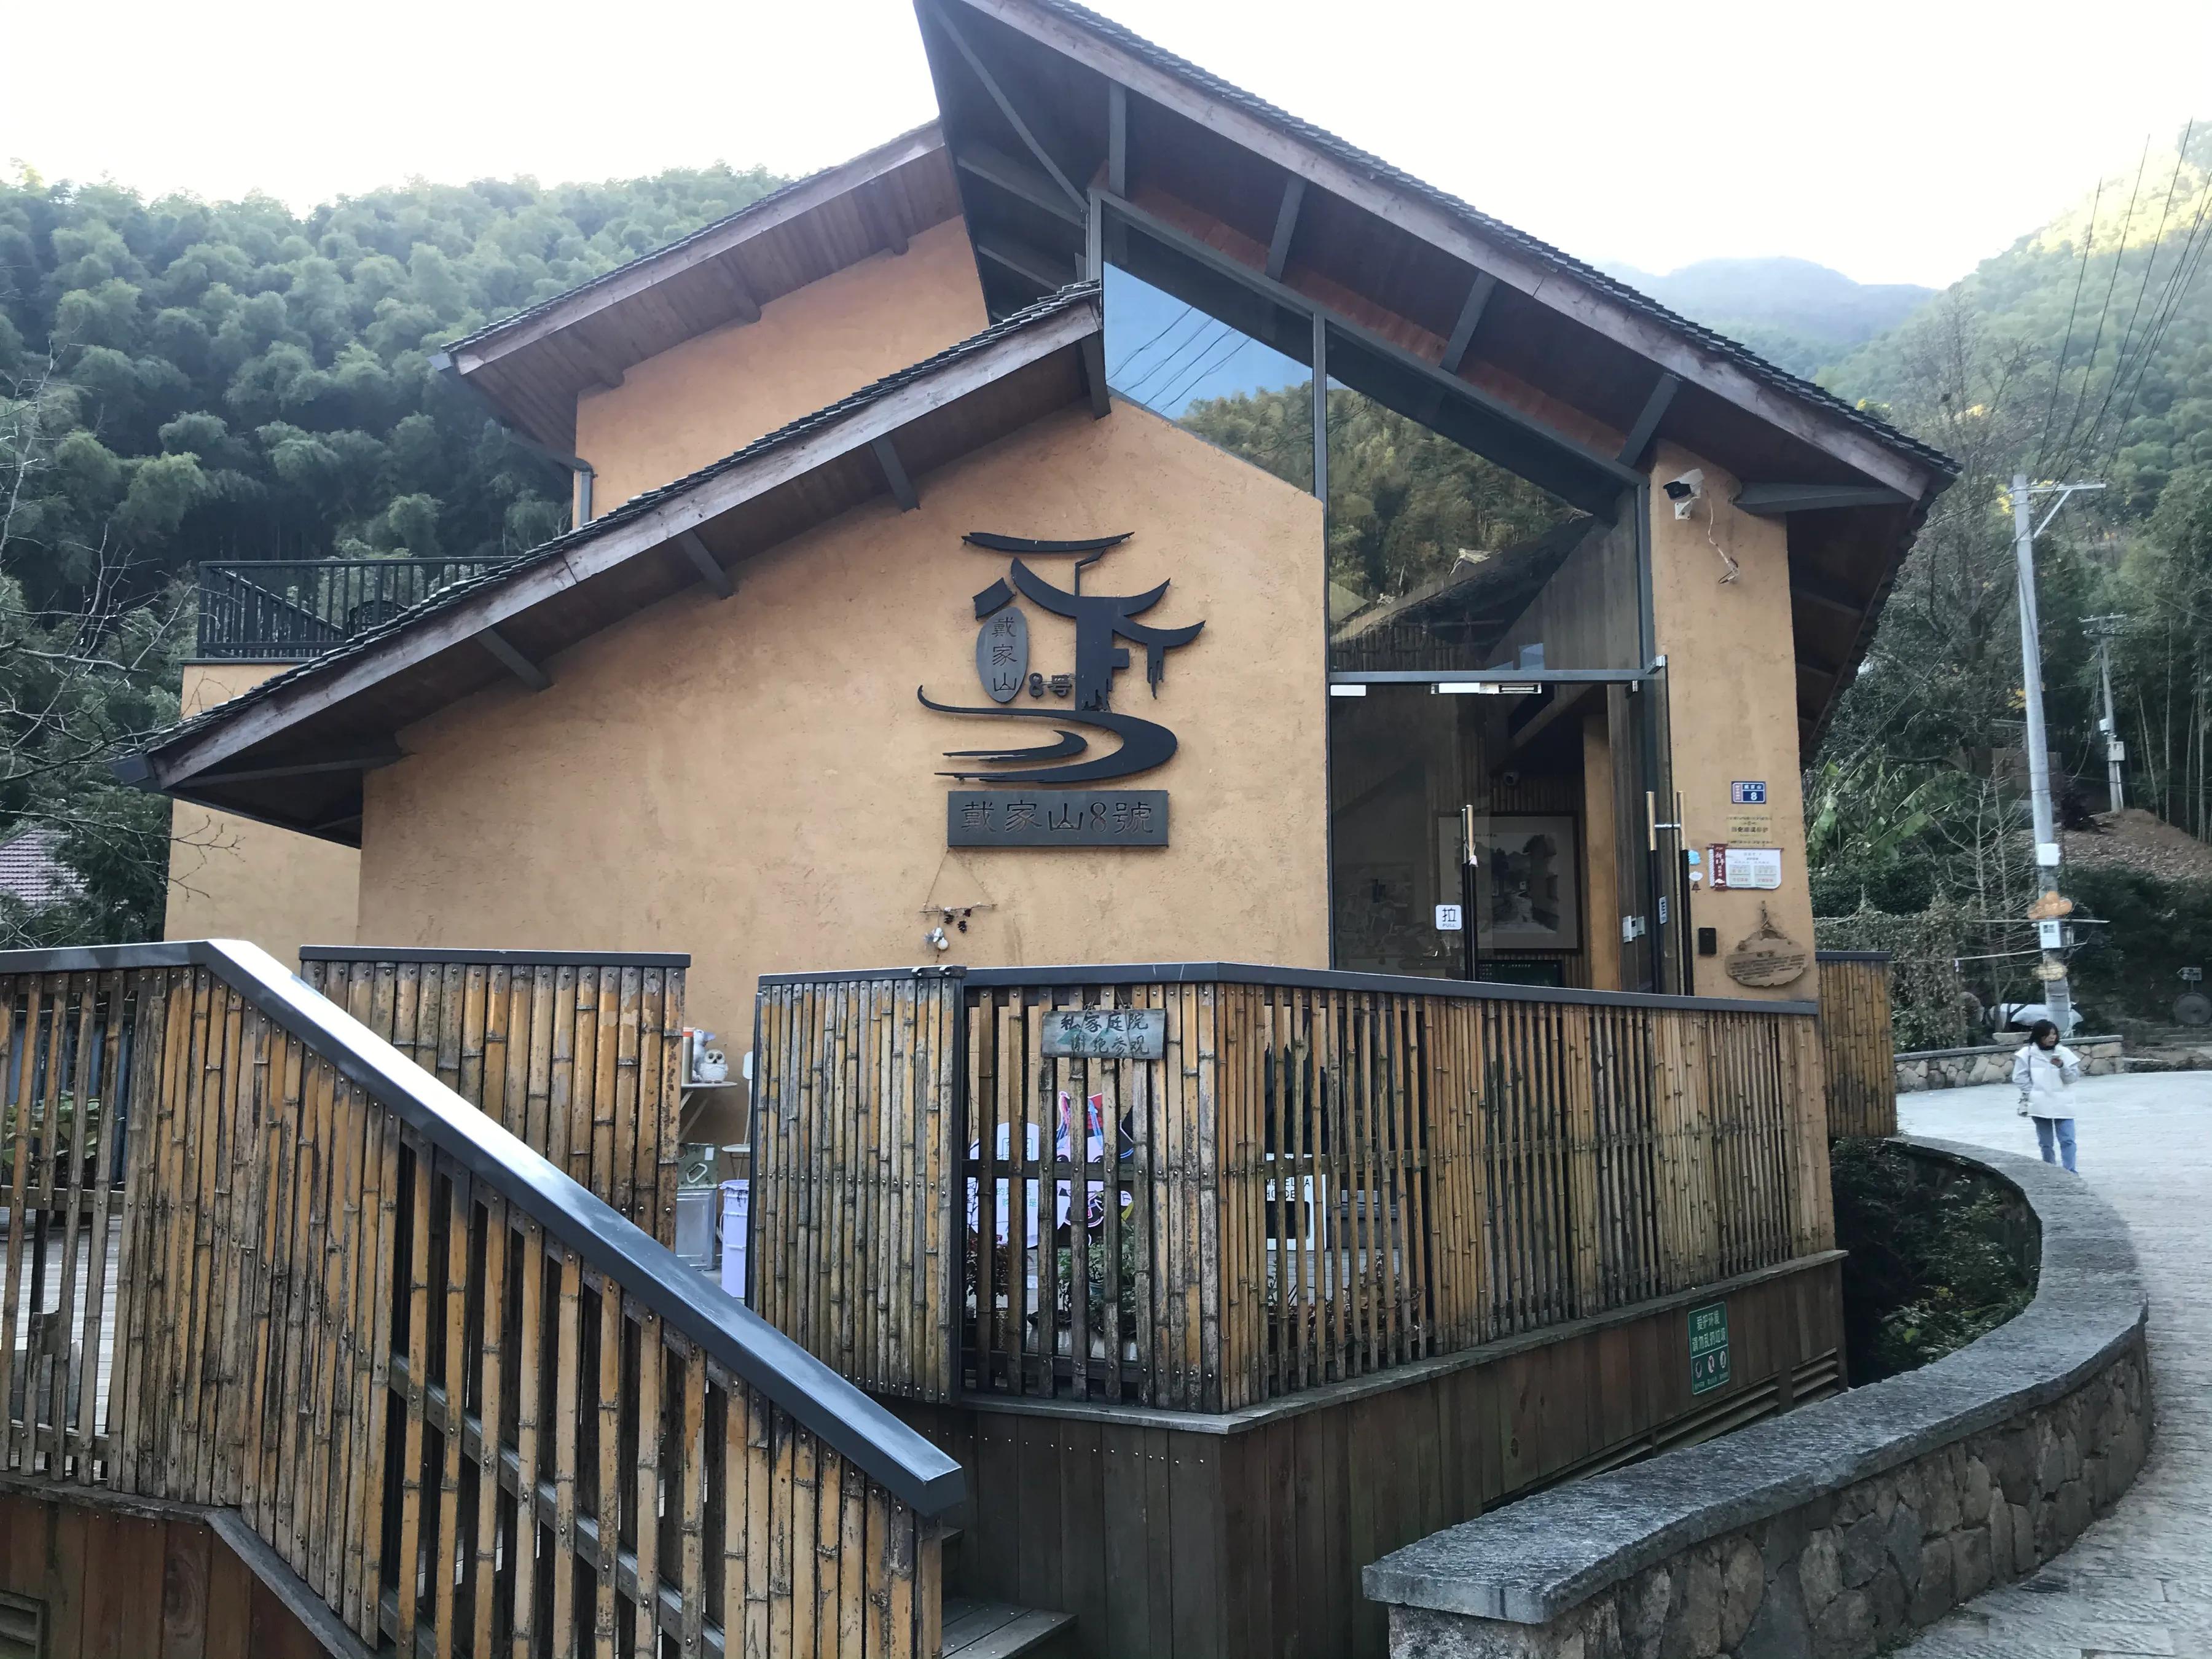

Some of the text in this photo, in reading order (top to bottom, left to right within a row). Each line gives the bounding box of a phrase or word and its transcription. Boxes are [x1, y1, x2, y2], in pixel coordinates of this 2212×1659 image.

[992, 616, 1017, 692] 戴家山
[1029, 672, 1072, 699] 8号
[1750, 791, 1758, 801] 8
[960, 799, 1154, 834] 戴家山8號
[1441, 908, 1457, 922] 拉
[1060, 1011, 1149, 1033] 私家庭院
[1070, 1035, 1150, 1057] 谢绝参观
